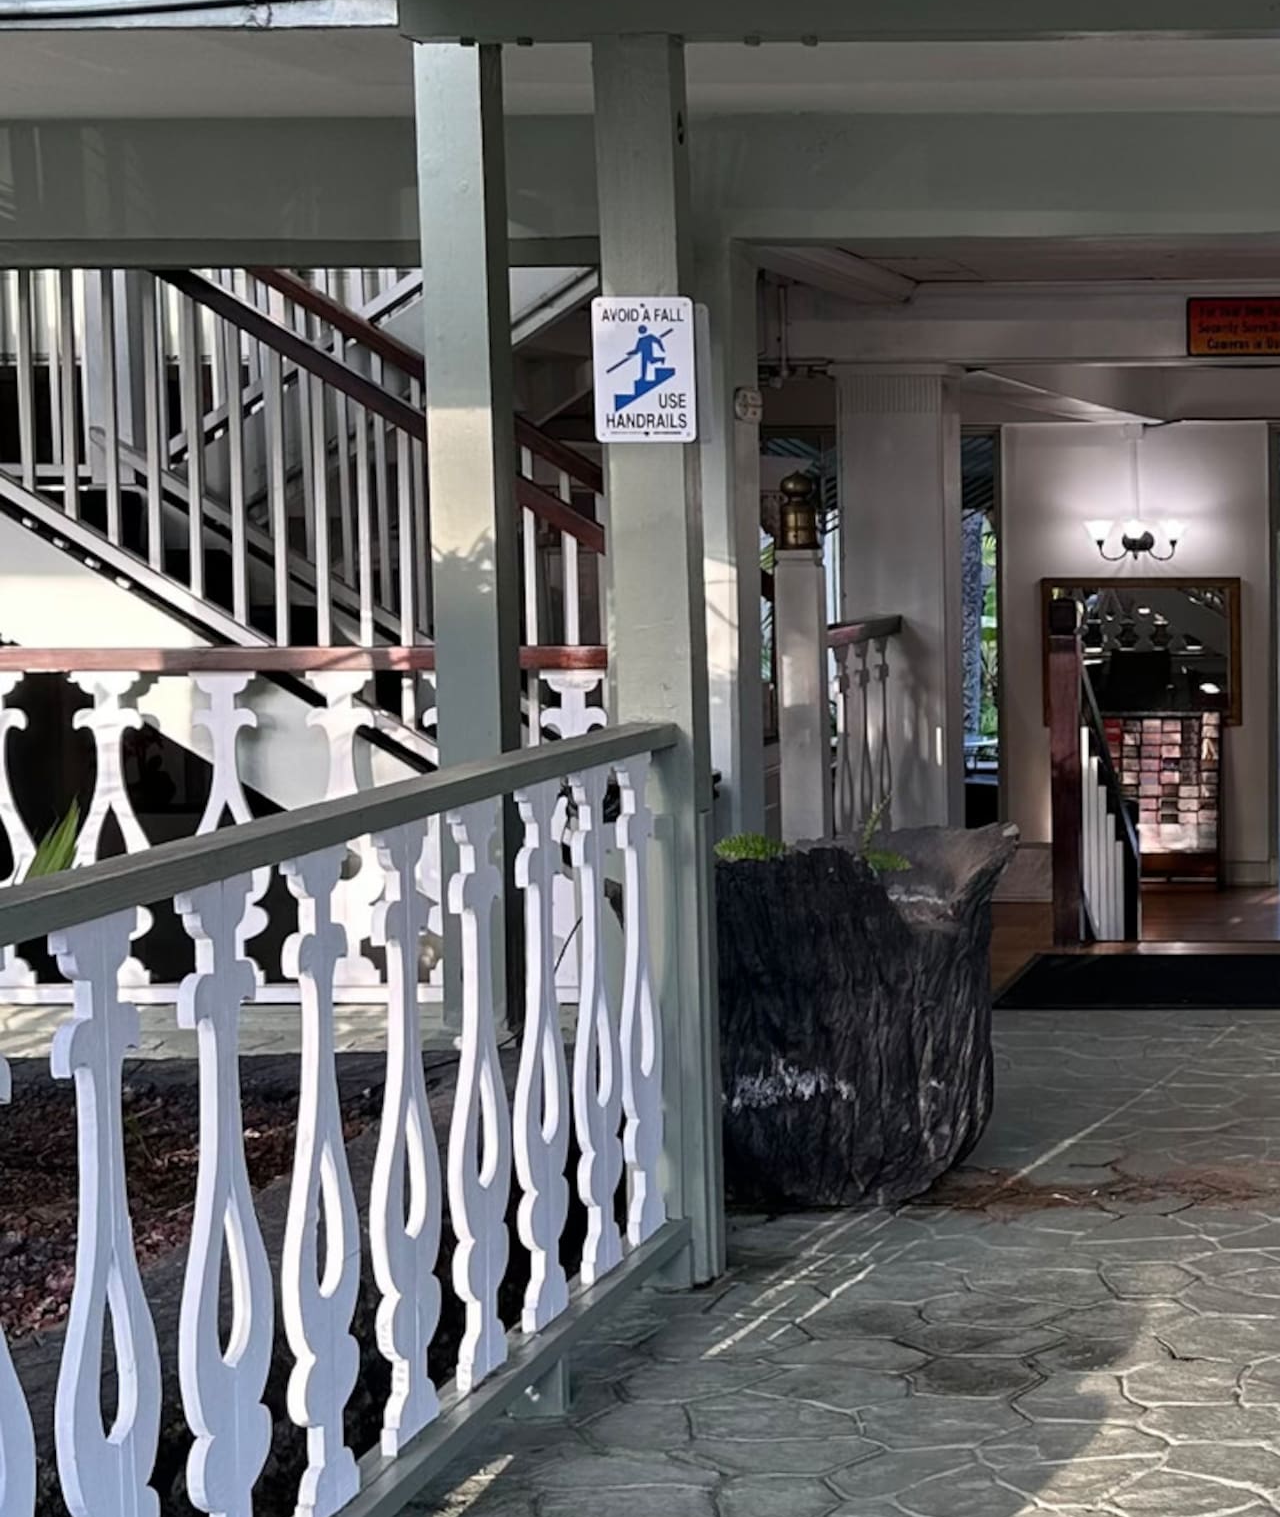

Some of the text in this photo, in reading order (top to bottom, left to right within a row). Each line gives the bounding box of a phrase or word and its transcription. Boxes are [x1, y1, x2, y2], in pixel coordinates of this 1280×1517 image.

[601, 308, 684, 322] AVOID A FALL
[1207, 337, 1250, 349] Cameras
[658, 393, 687, 409] USE
[606, 413, 687, 429] HANDRAILS
